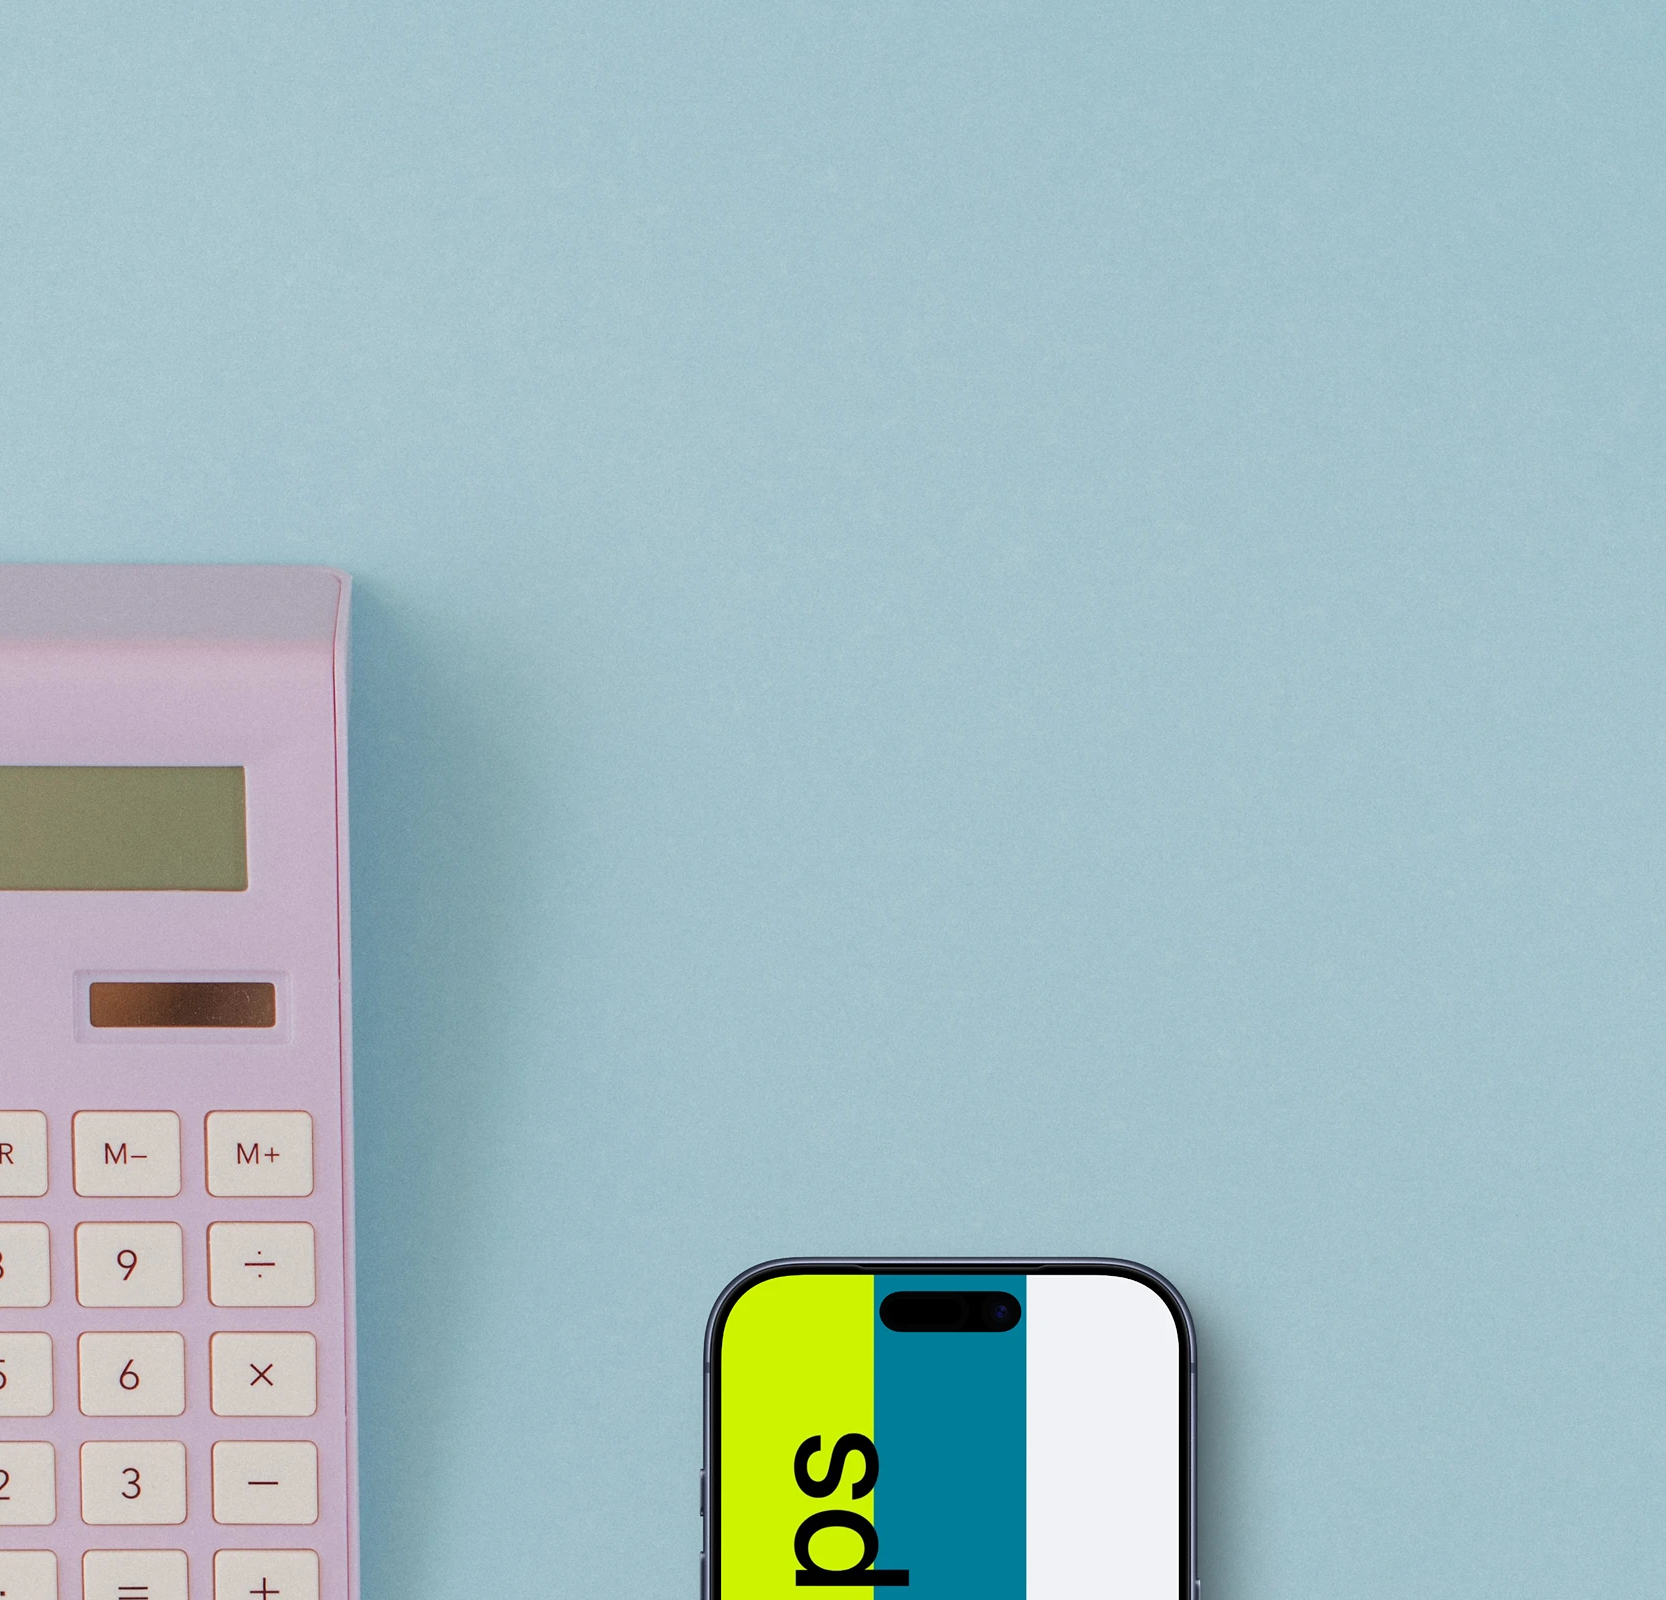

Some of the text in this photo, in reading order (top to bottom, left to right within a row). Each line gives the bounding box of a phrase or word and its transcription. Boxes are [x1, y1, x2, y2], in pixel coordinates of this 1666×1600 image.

[236, 1142, 281, 1165] M+
[116, 1249, 138, 1281] 9
[119, 1358, 140, 1391] 6
[121, 1467, 142, 1500] 3
[117, 1586, 149, 1600] =
